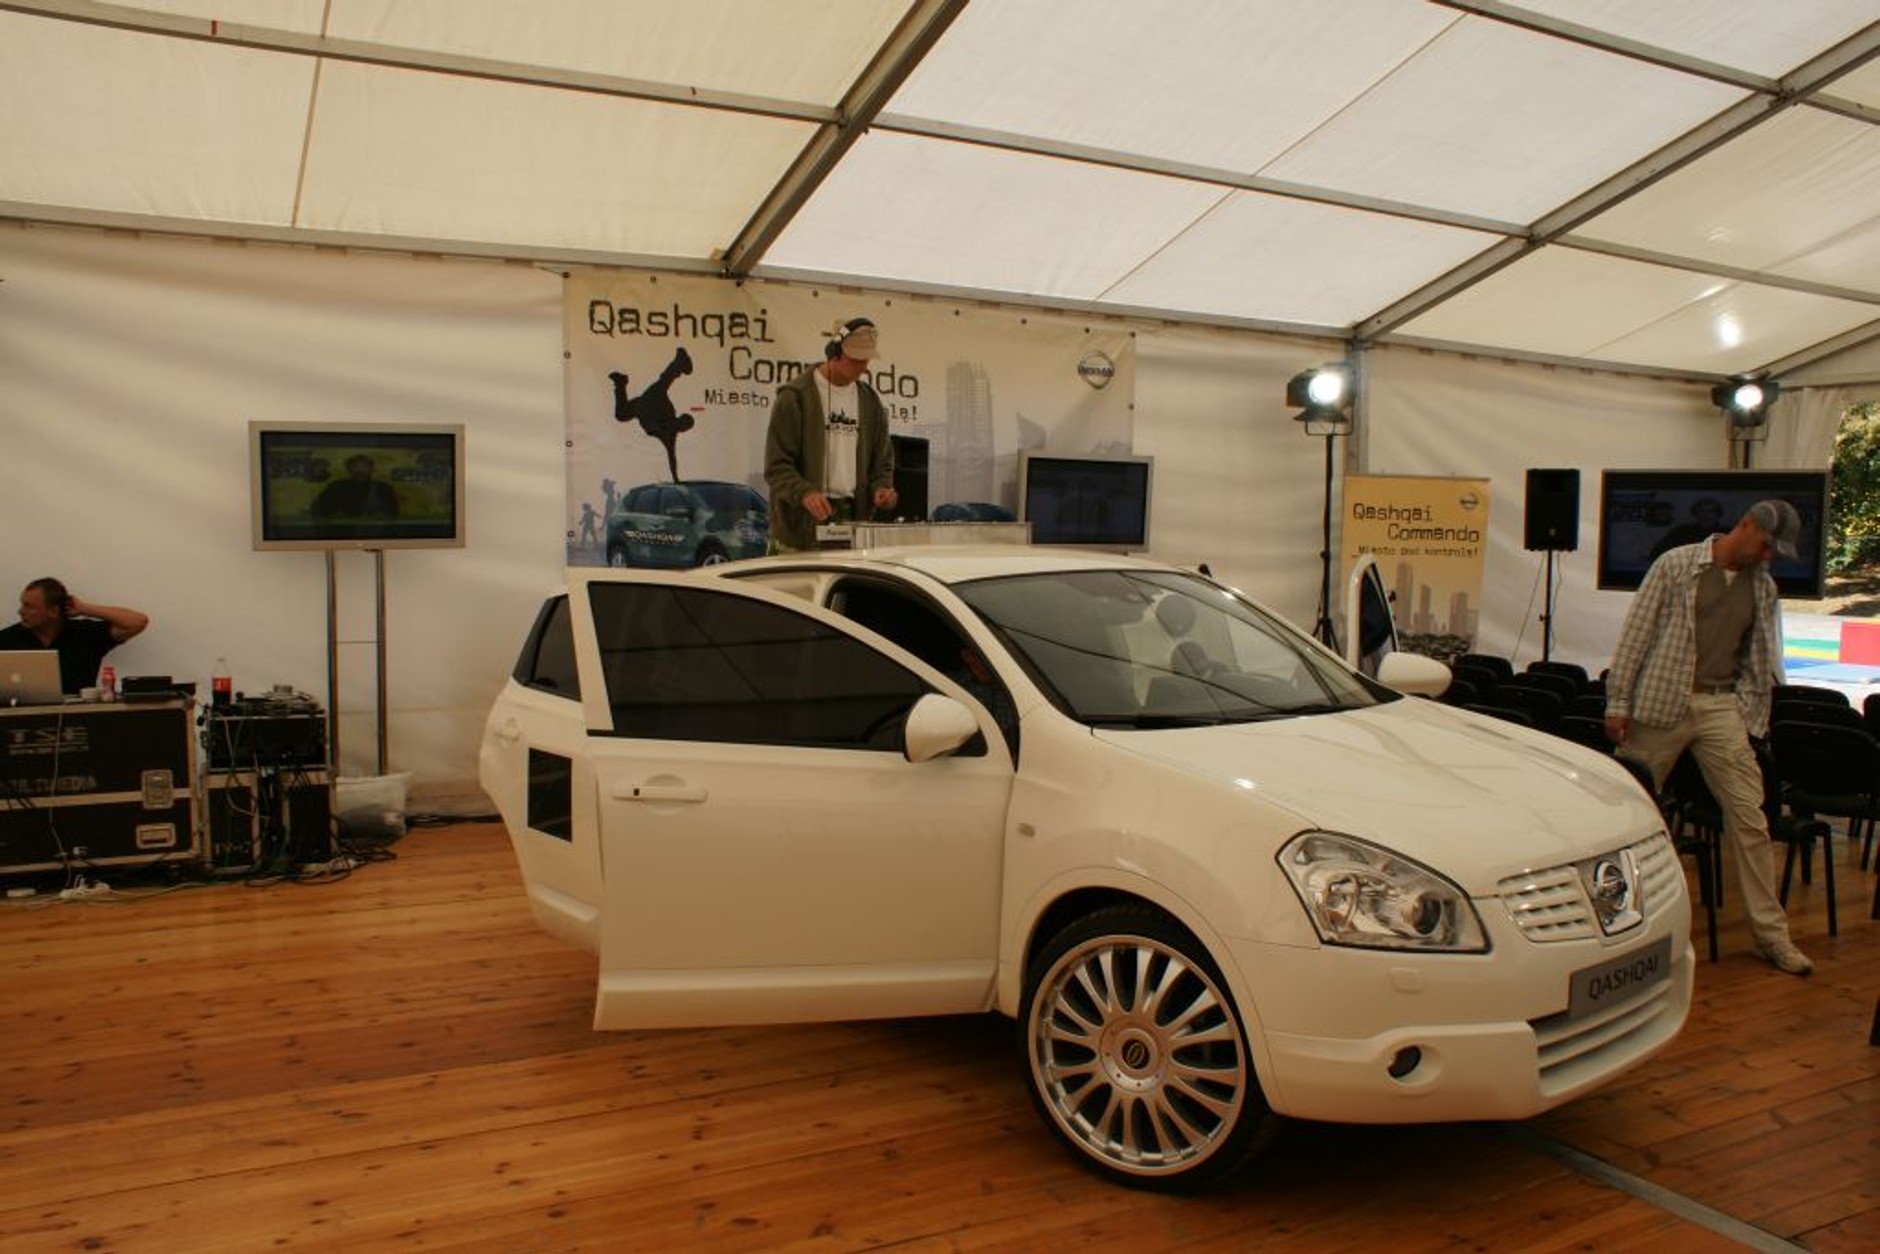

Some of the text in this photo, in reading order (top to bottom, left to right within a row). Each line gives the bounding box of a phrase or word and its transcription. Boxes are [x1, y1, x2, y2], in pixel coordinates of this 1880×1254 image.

[589, 300, 774, 347] Qashqai
[1353, 503, 1433, 523] Qashqai
[1388, 523, 1479, 542] Commando
[1589, 954, 1659, 1000] QASHQAI
